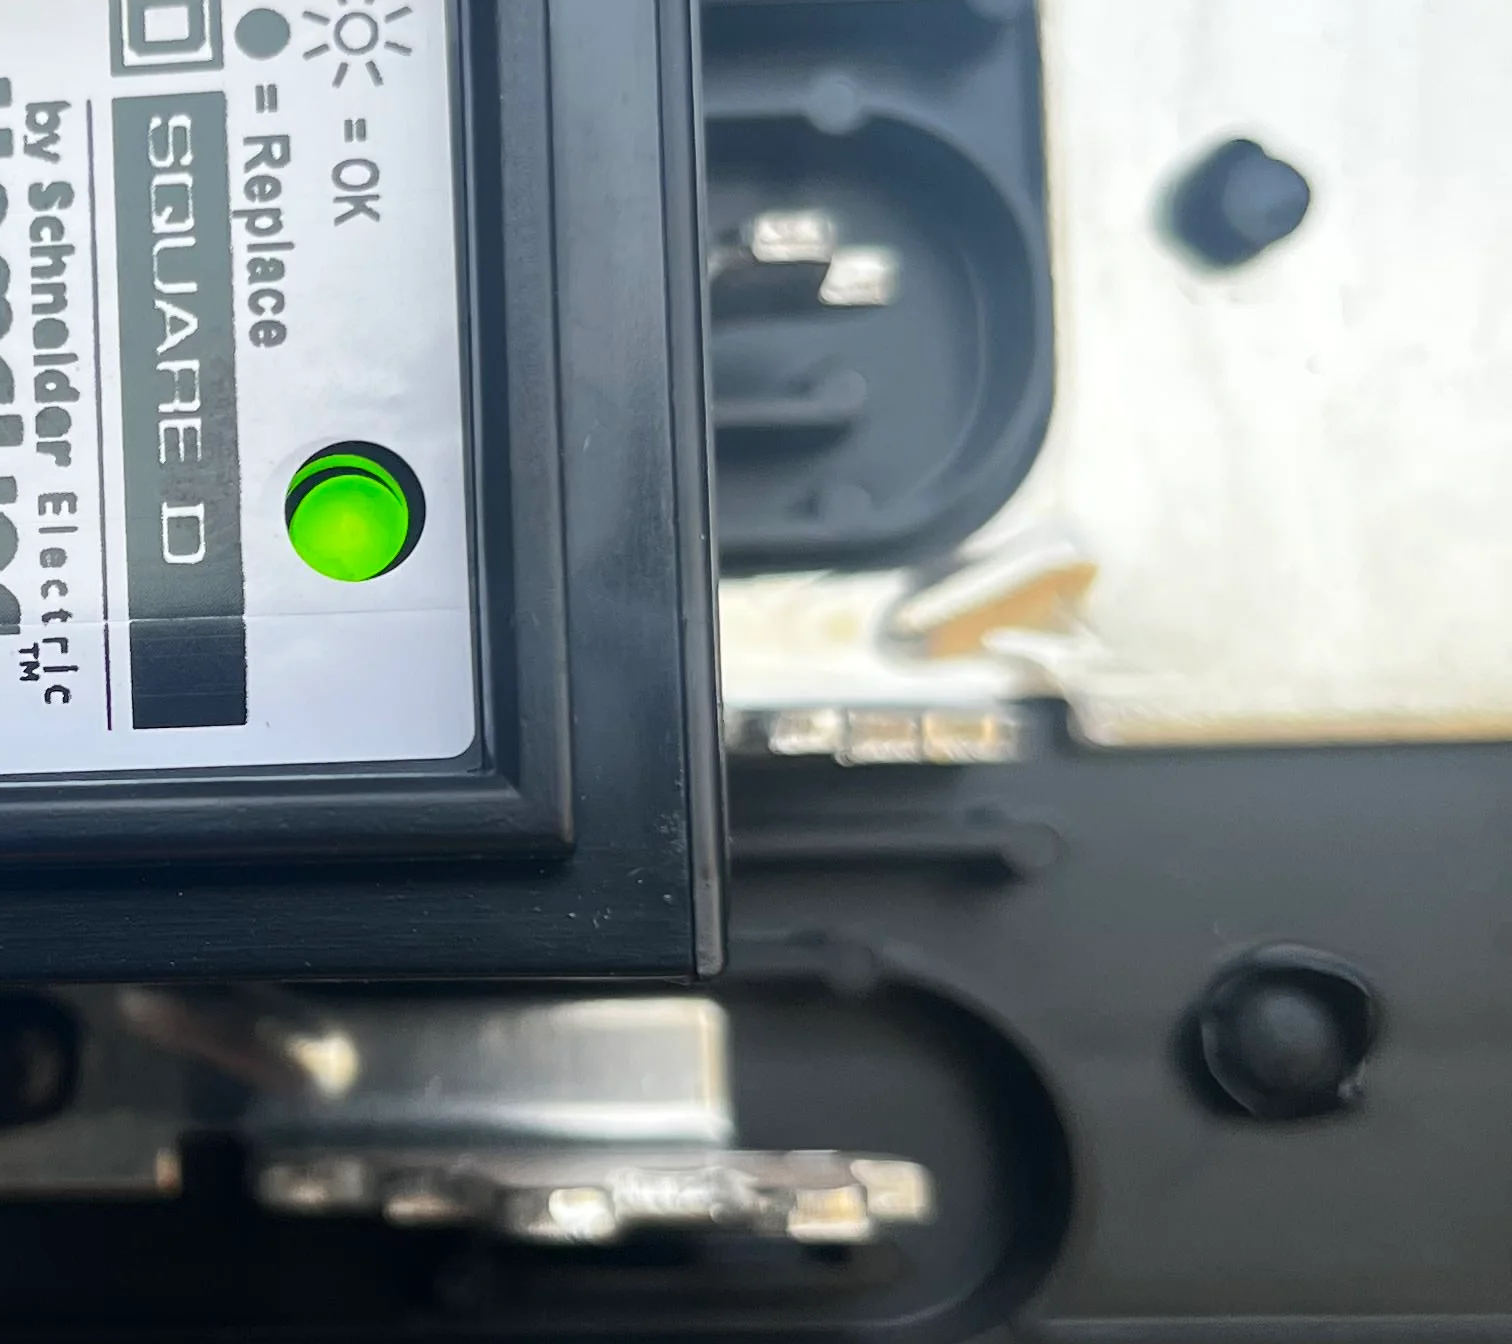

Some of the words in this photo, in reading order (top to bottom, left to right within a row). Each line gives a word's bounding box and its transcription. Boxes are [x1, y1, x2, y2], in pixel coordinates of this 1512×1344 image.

[23, 101, 72, 163] by
[331, 158, 381, 227] OK
[28, 182, 80, 467] Schneider
[148, 114, 205, 463] SQUARE
[232, 134, 295, 348] Replace
[36, 491, 79, 705] Electric
[159, 502, 206, 564] D
